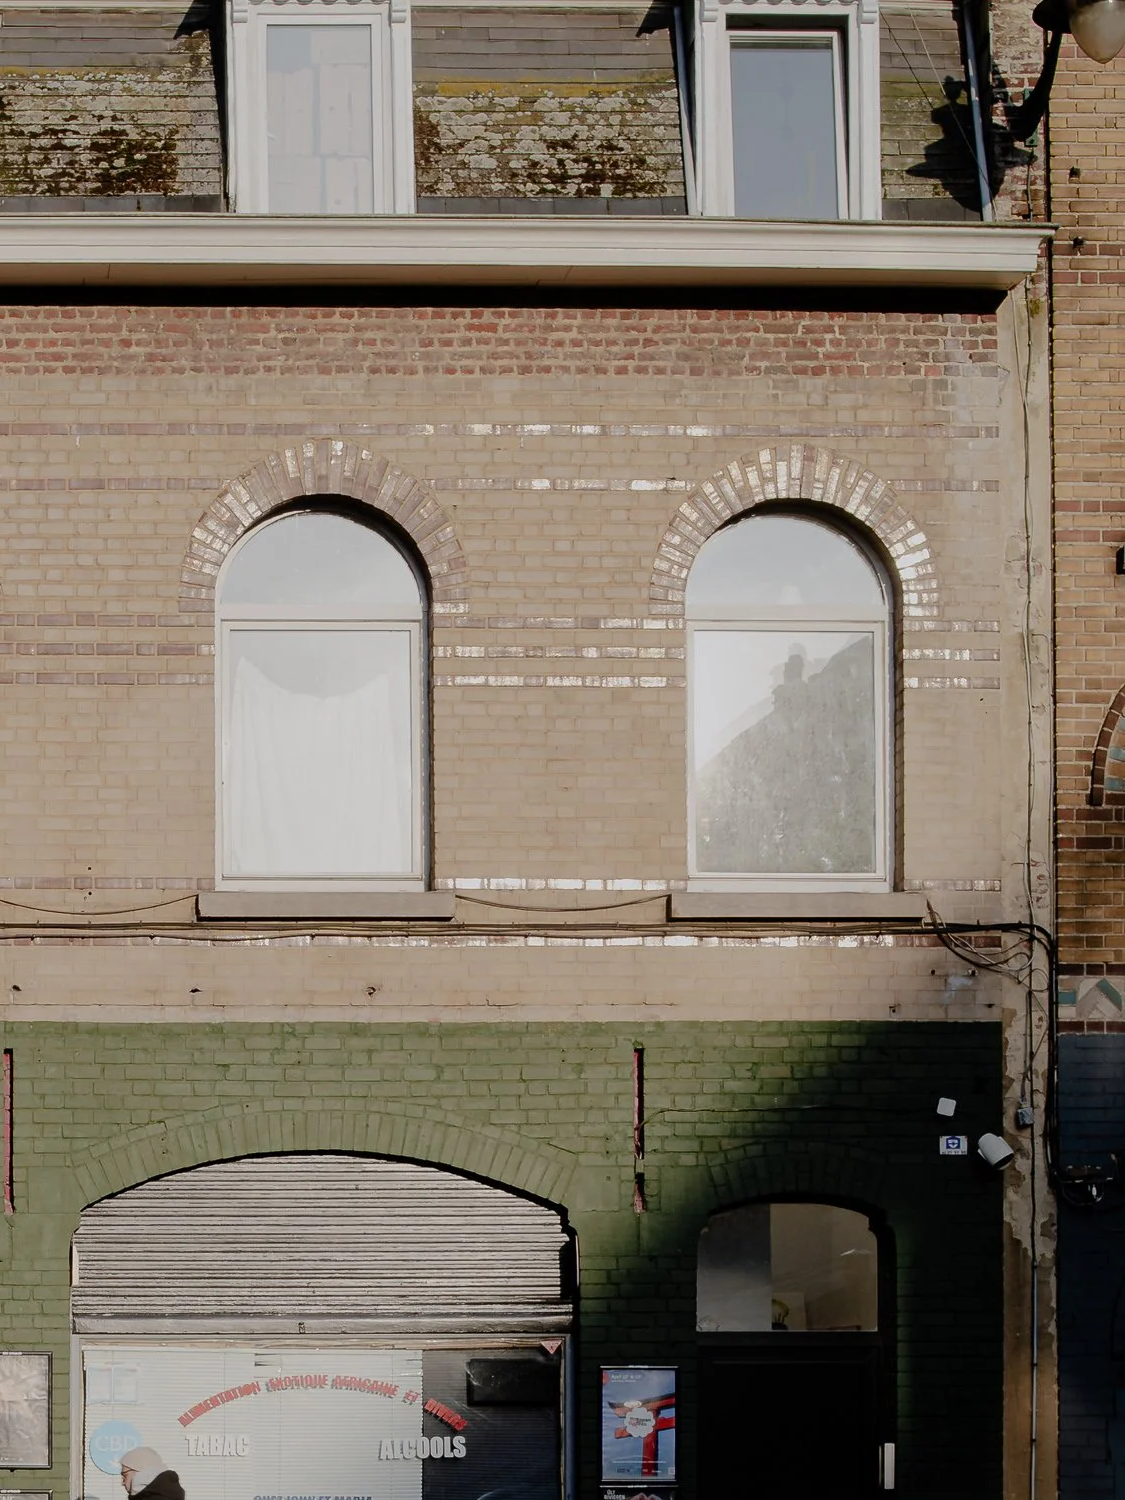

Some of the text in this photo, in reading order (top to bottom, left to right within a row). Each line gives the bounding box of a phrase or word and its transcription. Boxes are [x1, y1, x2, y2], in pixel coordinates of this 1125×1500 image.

[178, 1374, 468, 1431] ALIMENTATION EXOTIQUE AFRICAINE ET DIVERS
[95, 1435, 137, 1452] CBD
[185, 1434, 467, 1460] TABAC ALCOOLS
